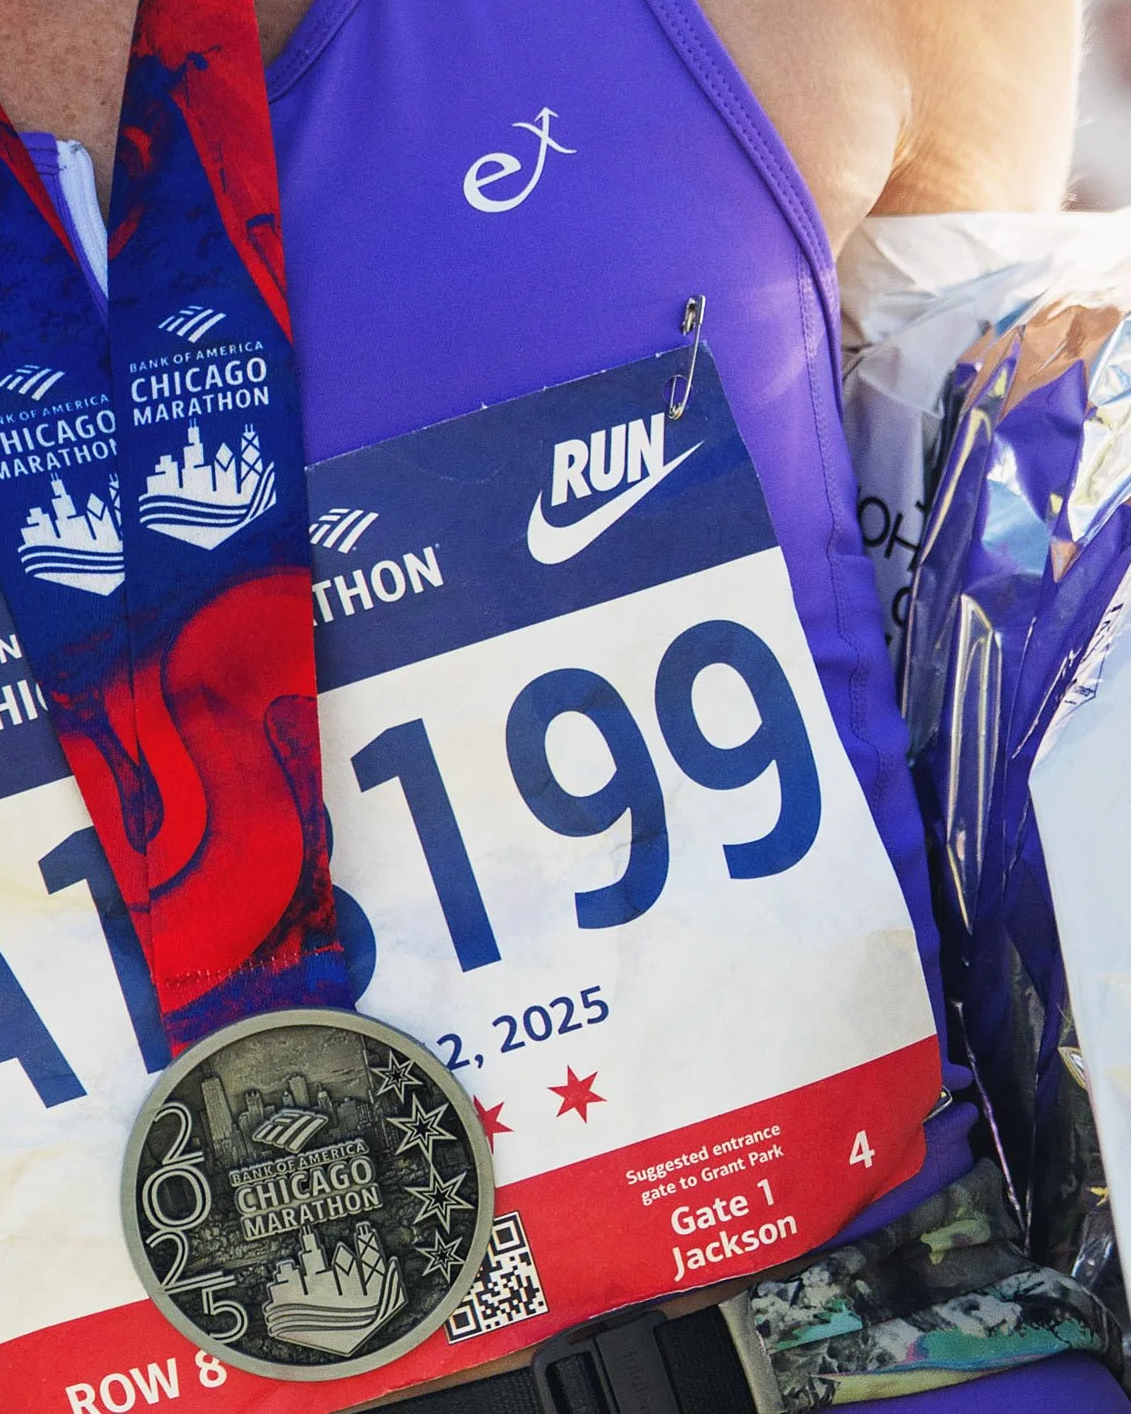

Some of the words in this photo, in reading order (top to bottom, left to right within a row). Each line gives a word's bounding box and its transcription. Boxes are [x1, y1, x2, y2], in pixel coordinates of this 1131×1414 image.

[130, 356, 169, 374] BANK
[172, 351, 193, 365] OF
[195, 340, 265, 361] AMERICA
[130, 357, 267, 403] CHICAGO
[18, 409, 38, 422] OF
[41, 393, 111, 417] AMERICA
[133, 386, 269, 427] MARATHON
[551, 412, 666, 507] RUN
[312, 546, 446, 627] THON
[492, 985, 610, 1054] 2025
[232, 1166, 274, 1184] BANK
[276, 1159, 296, 1173] OF
[298, 1142, 366, 1168] AMERICA
[625, 1145, 709, 1186] Suggested
[712, 1124, 782, 1156] entrance
[641, 1182, 677, 1207] gate
[679, 1174, 698, 1191] to
[701, 1155, 747, 1183] Grant
[747, 1143, 785, 1167] Park
[848, 1129, 876, 1169] 4
[237, 1156, 373, 1214] CHICAGO
[243, 1186, 381, 1240] MARATHON
[671, 1192, 750, 1236] Gate
[757, 1178, 775, 1207] 1
[671, 1214, 798, 1283] Jackson
[65, 1357, 181, 1414] ROW
